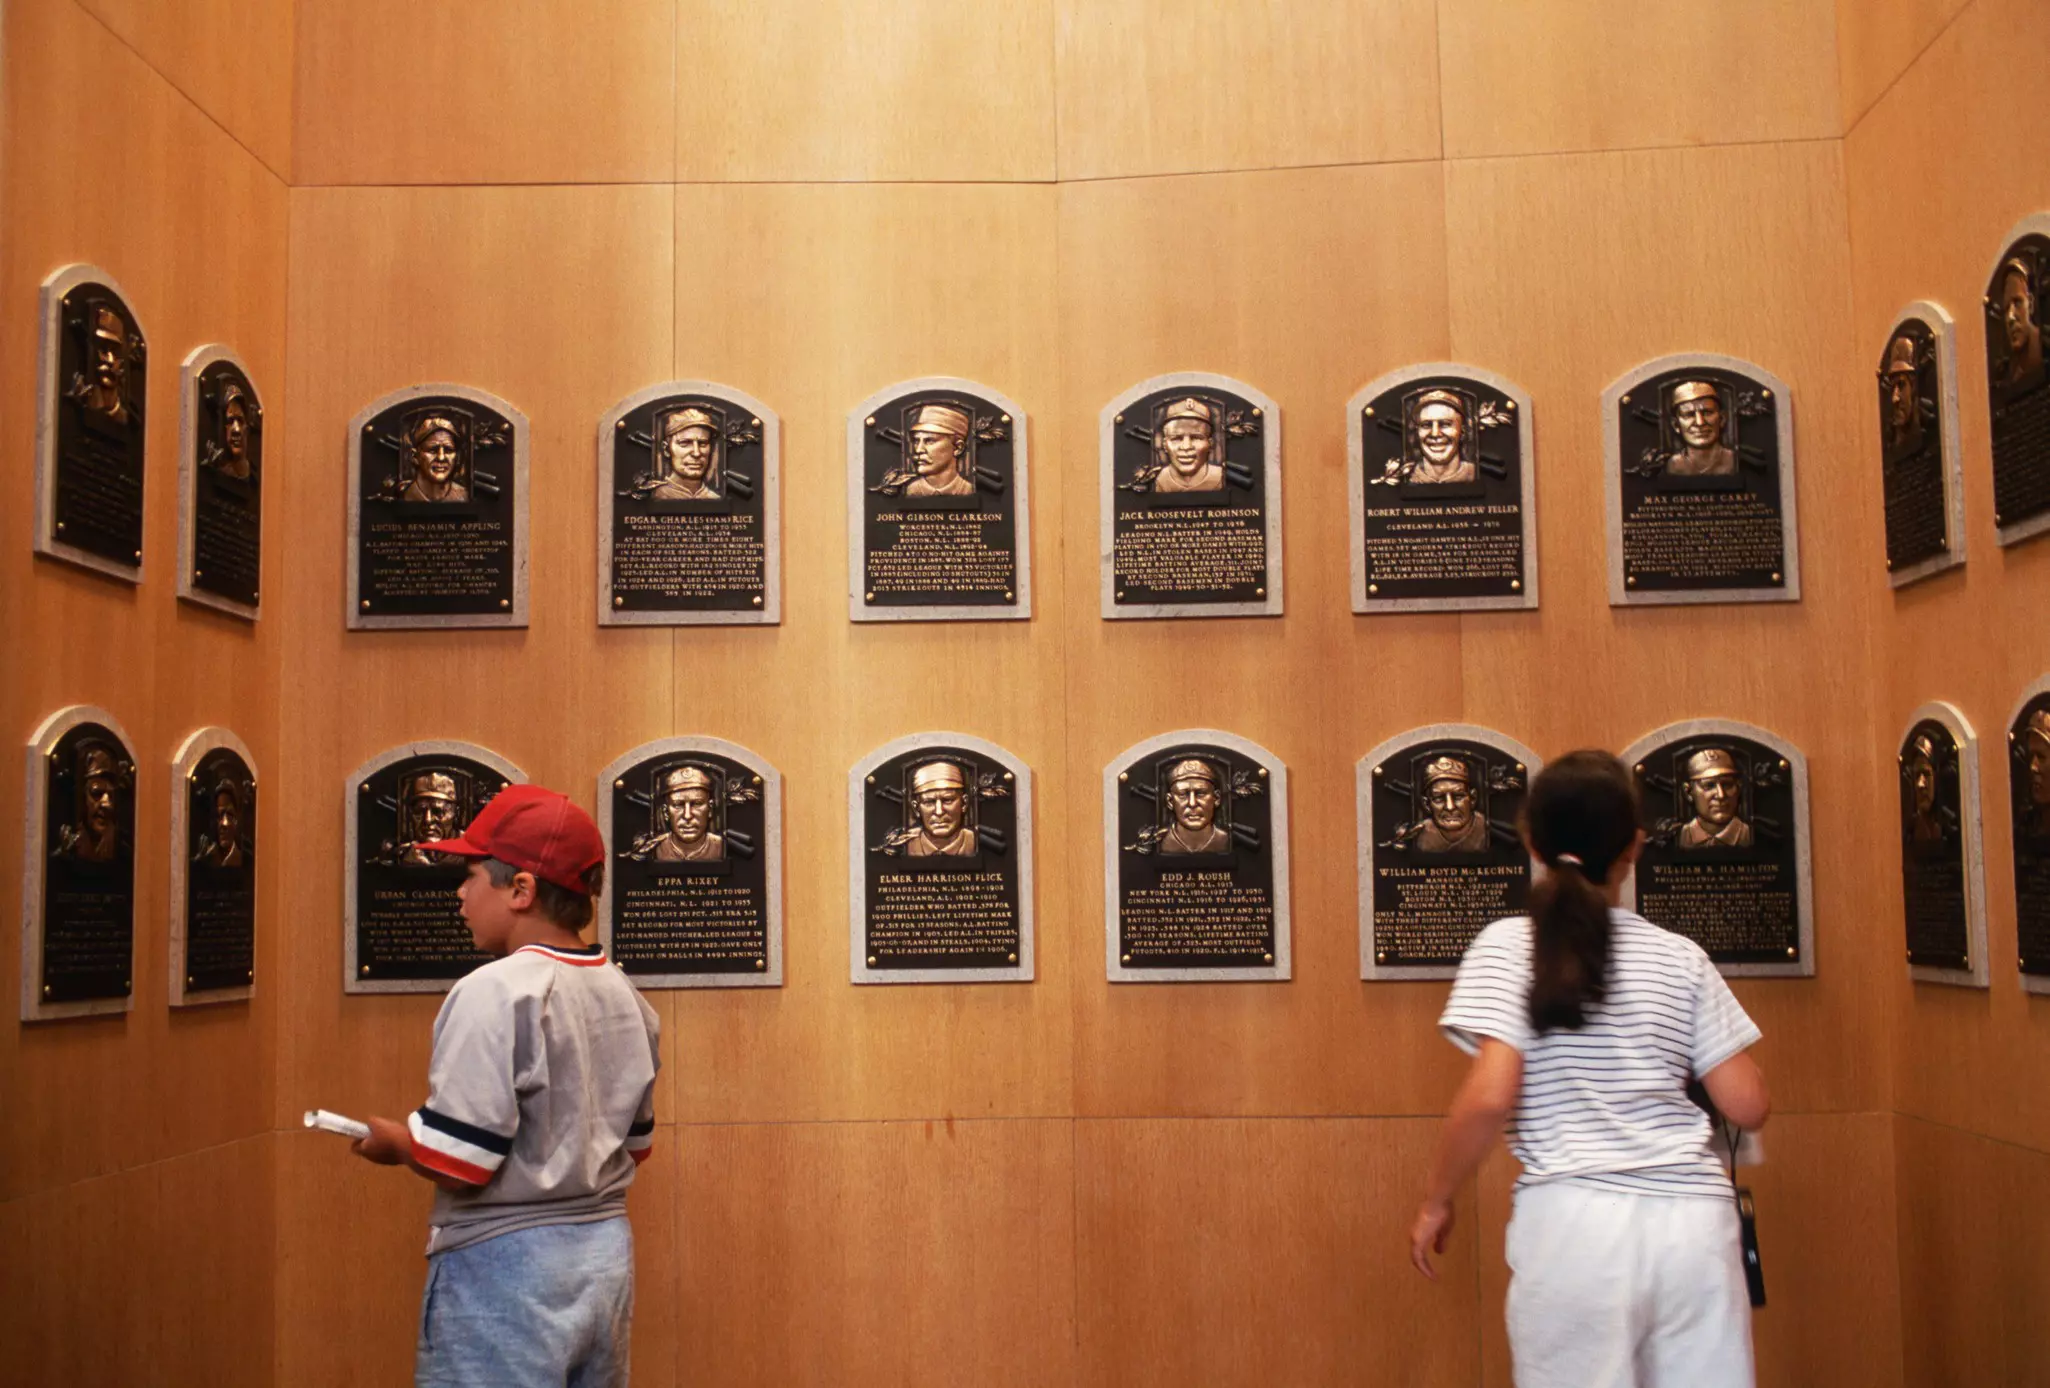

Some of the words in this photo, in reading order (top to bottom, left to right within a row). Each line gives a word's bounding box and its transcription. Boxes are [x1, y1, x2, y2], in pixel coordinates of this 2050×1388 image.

[1644, 496, 1667, 504] MAX
[1672, 495, 1714, 503] GEORGE
[1120, 512, 1144, 520] JACK
[1147, 510, 1204, 520] ROOSEVELT
[1208, 508, 1260, 518] ROBINSON
[1368, 508, 1400, 517] ROBERT
[1404, 508, 1443, 516] WILLIAM
[1446, 506, 1485, 515] ANDREW
[1488, 504, 1519, 514] FELLER
[624, 516, 656, 524] EDGAR
[660, 516, 704, 524] CHARLES
[732, 516, 754, 524] RICE
[876, 514, 904, 522] JOHN
[948, 513, 1002, 521] CLARKSON
[408, 523, 456, 531] BENJAMIN
[461, 522, 500, 530] APPLING
[1162, 873, 1183, 882] EDD
[1187, 872, 1194, 881] J.
[1198, 872, 1230, 881] ROUSH
[1380, 868, 1426, 877] WILLIAM
[1430, 868, 1458, 876] BOYD
[658, 878, 682, 886] EPPA
[687, 876, 718, 885] RIXEY
[880, 874, 912, 884] ELMER
[918, 874, 971, 883] HARRISON
[975, 873, 1003, 882] FLICK
[374, 890, 406, 900] URBAN
[412, 890, 457, 900] CLARENC
